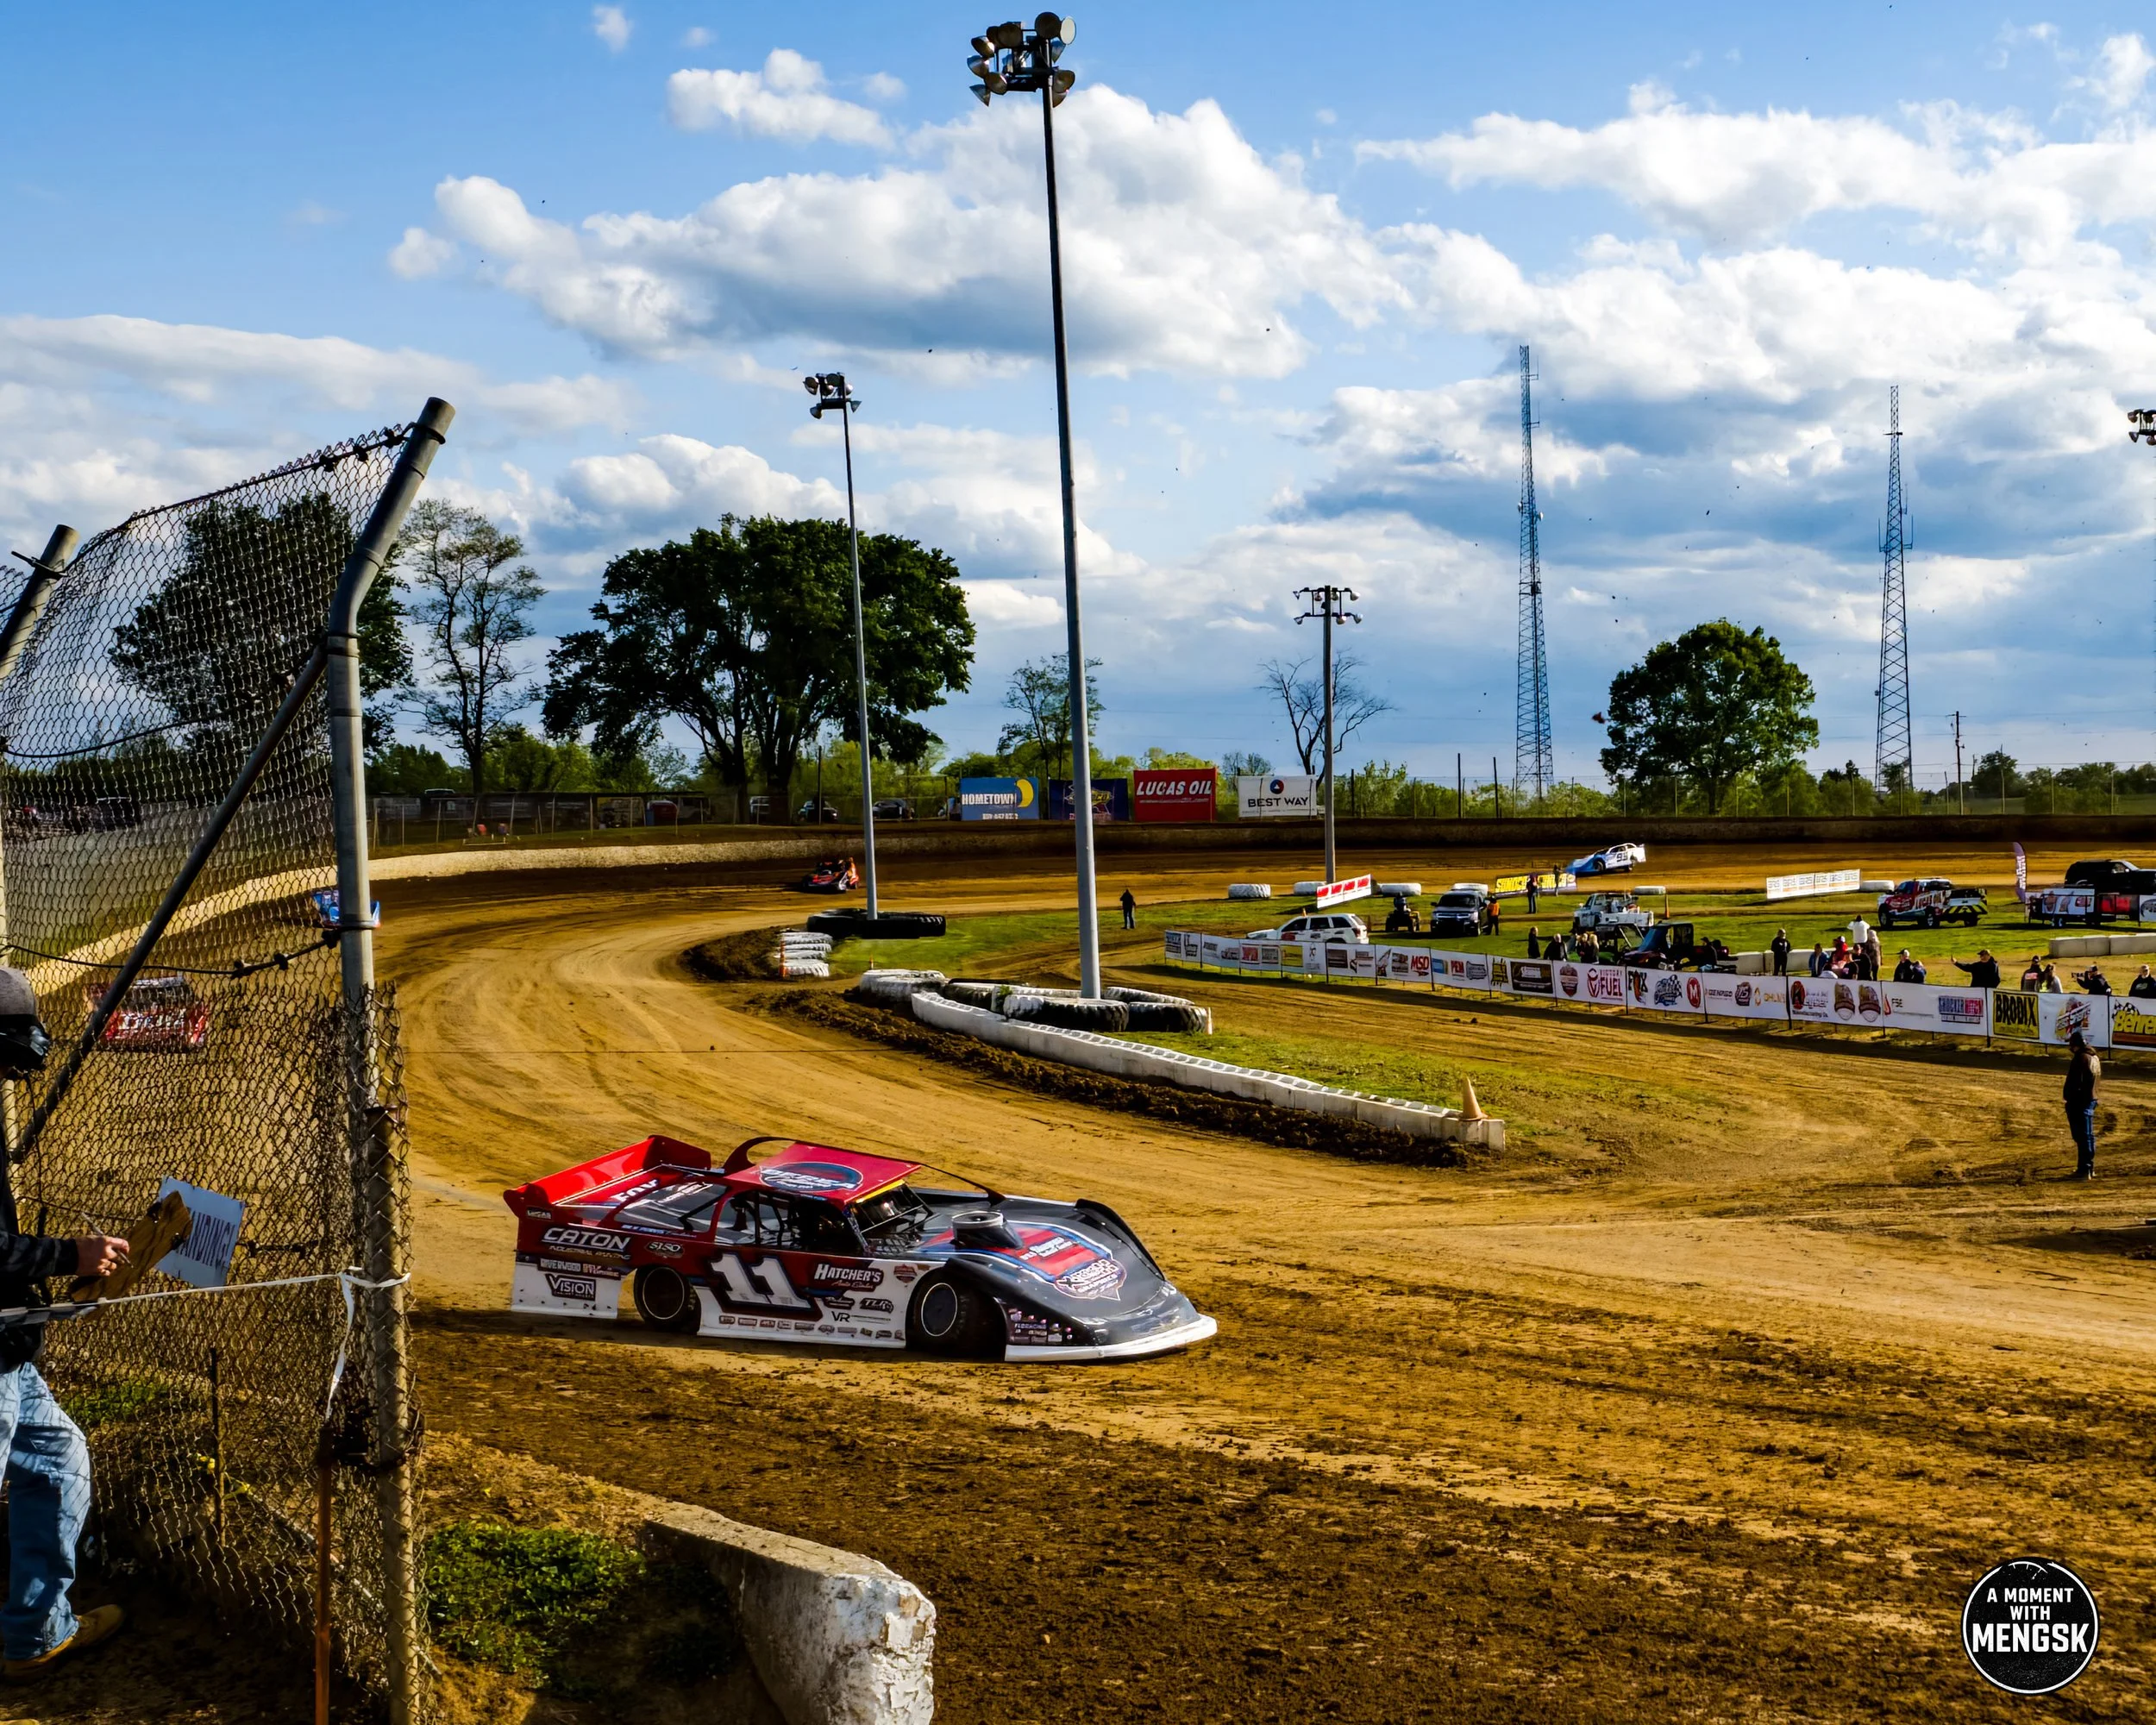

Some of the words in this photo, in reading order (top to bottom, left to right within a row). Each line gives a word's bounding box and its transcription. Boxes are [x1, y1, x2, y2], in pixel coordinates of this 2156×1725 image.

[1137, 781, 1185, 796] LUCAS
[1189, 780, 1212, 794] OIL
[962, 793, 1017, 806] HOMETOWN
[1248, 798, 1282, 807] BEST
[1285, 797, 1309, 806] WAY
[1600, 975, 1622, 996] FUEL
[1995, 994, 2037, 1027] BRODIX
[542, 1227, 632, 1251] CATON
[711, 1252, 812, 1309] 11
[814, 1264, 882, 1283] HATCHER'S
[548, 1276, 595, 1297] VISION
